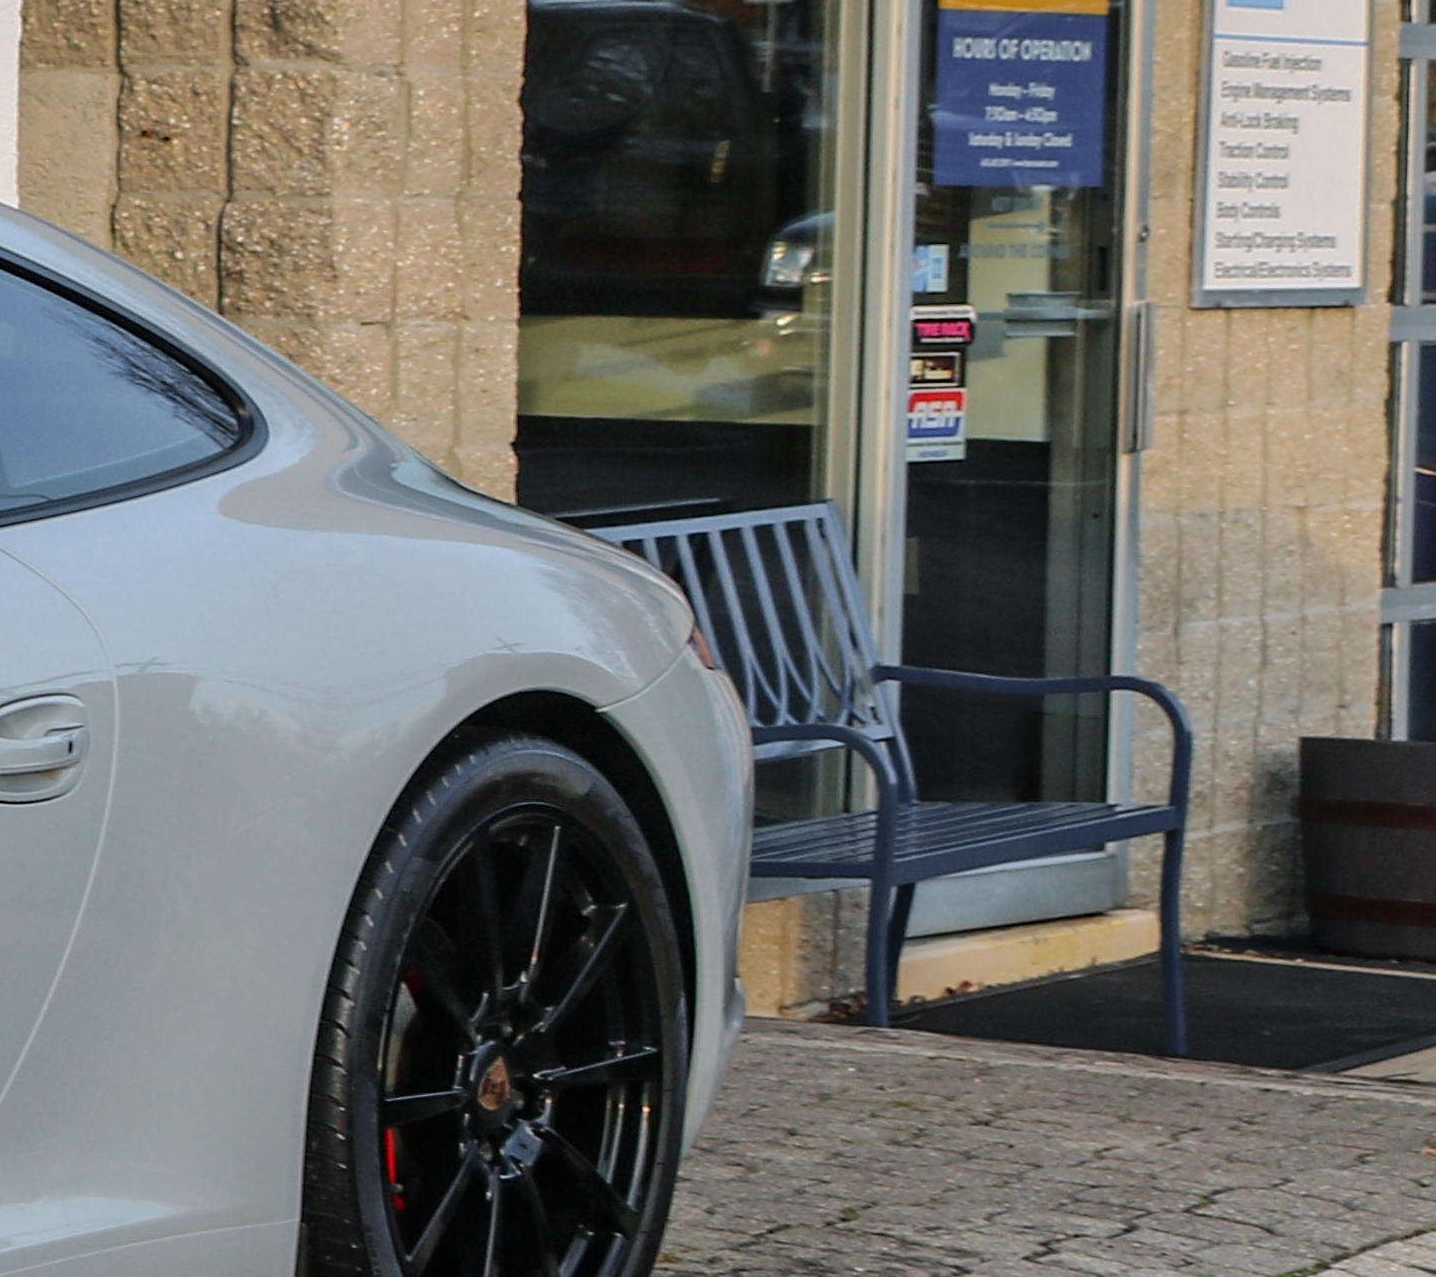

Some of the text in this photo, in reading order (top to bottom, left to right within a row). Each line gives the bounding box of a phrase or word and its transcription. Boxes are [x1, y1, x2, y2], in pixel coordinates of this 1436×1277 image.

[952, 37, 1092, 61] HOURS OF OPERATION
